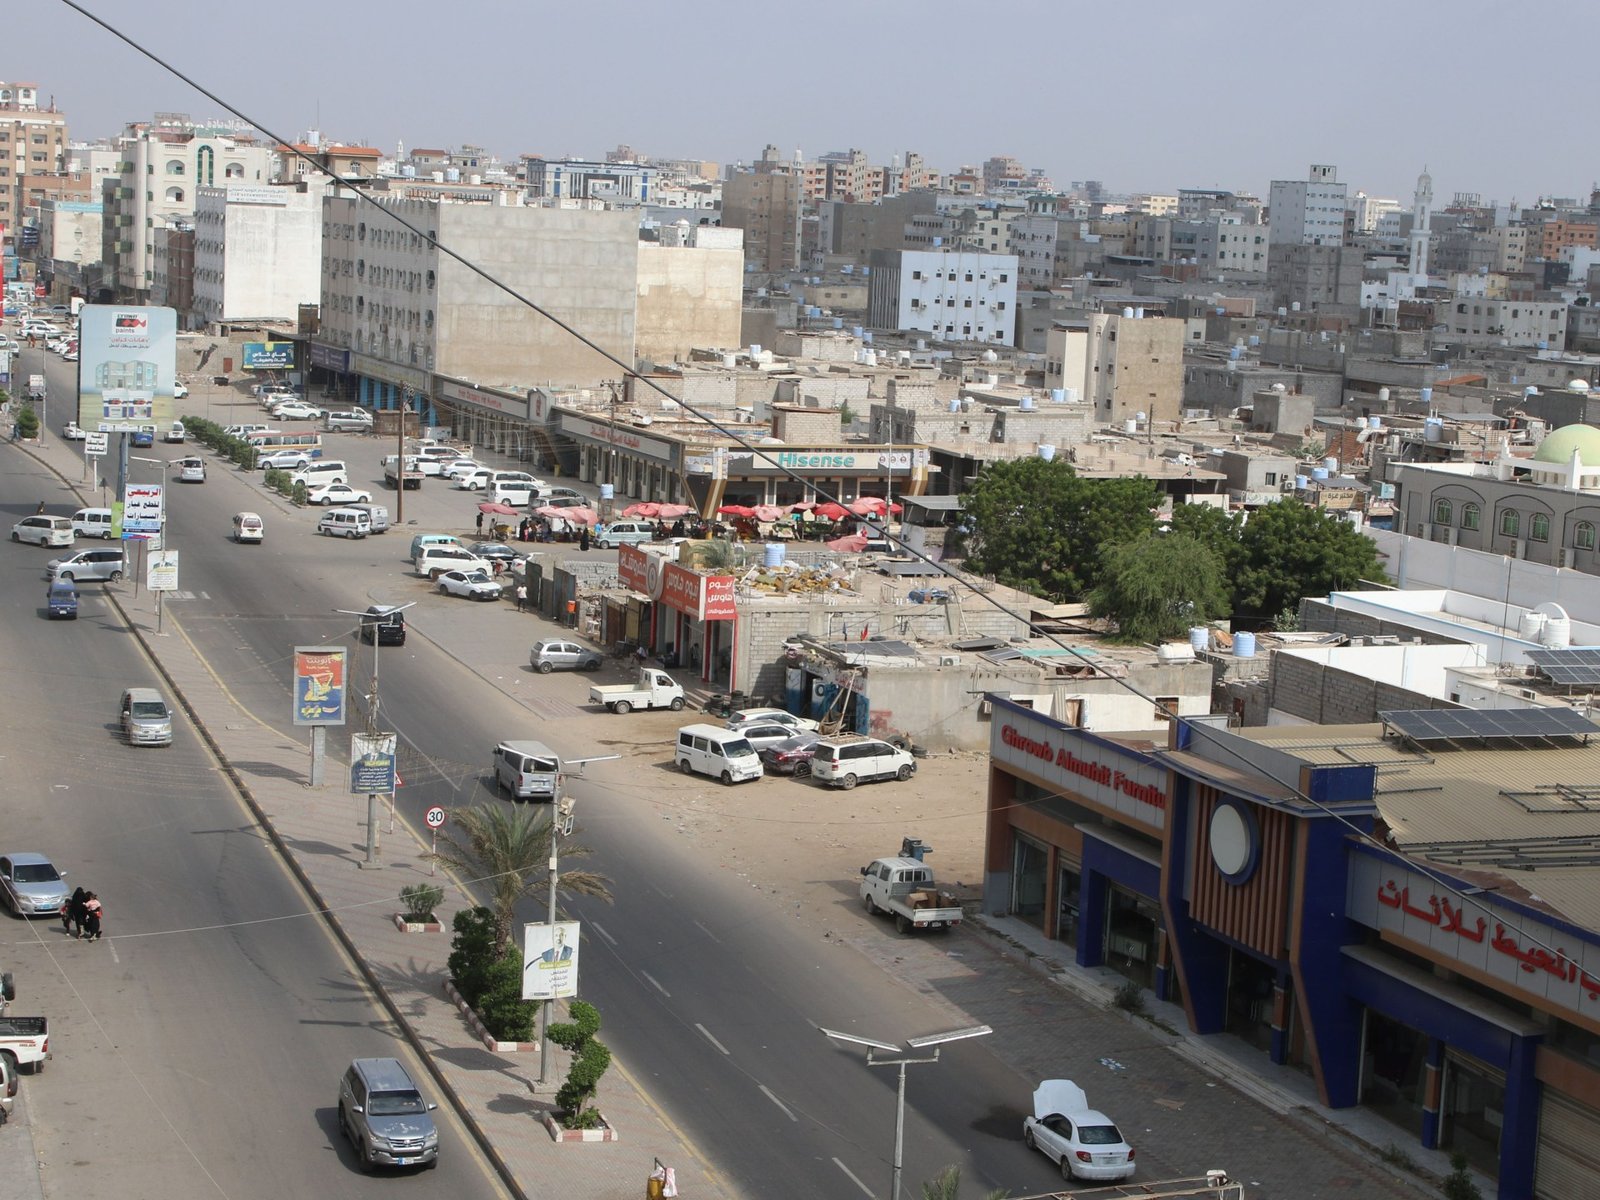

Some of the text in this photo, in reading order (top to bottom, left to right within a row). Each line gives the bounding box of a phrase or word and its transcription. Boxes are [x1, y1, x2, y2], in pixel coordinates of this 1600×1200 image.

[777, 451, 856, 467] Hisense
[1339, 492, 1354, 500] مختبر
[127, 512, 159, 520] السيارات
[666, 571, 684, 592] هاوس
[707, 594, 733, 603] هاوس
[1055, 748, 1111, 787] Almuhit
[428, 811, 443, 822] 30
[1377, 879, 1577, 983] المحيط للأثاث
